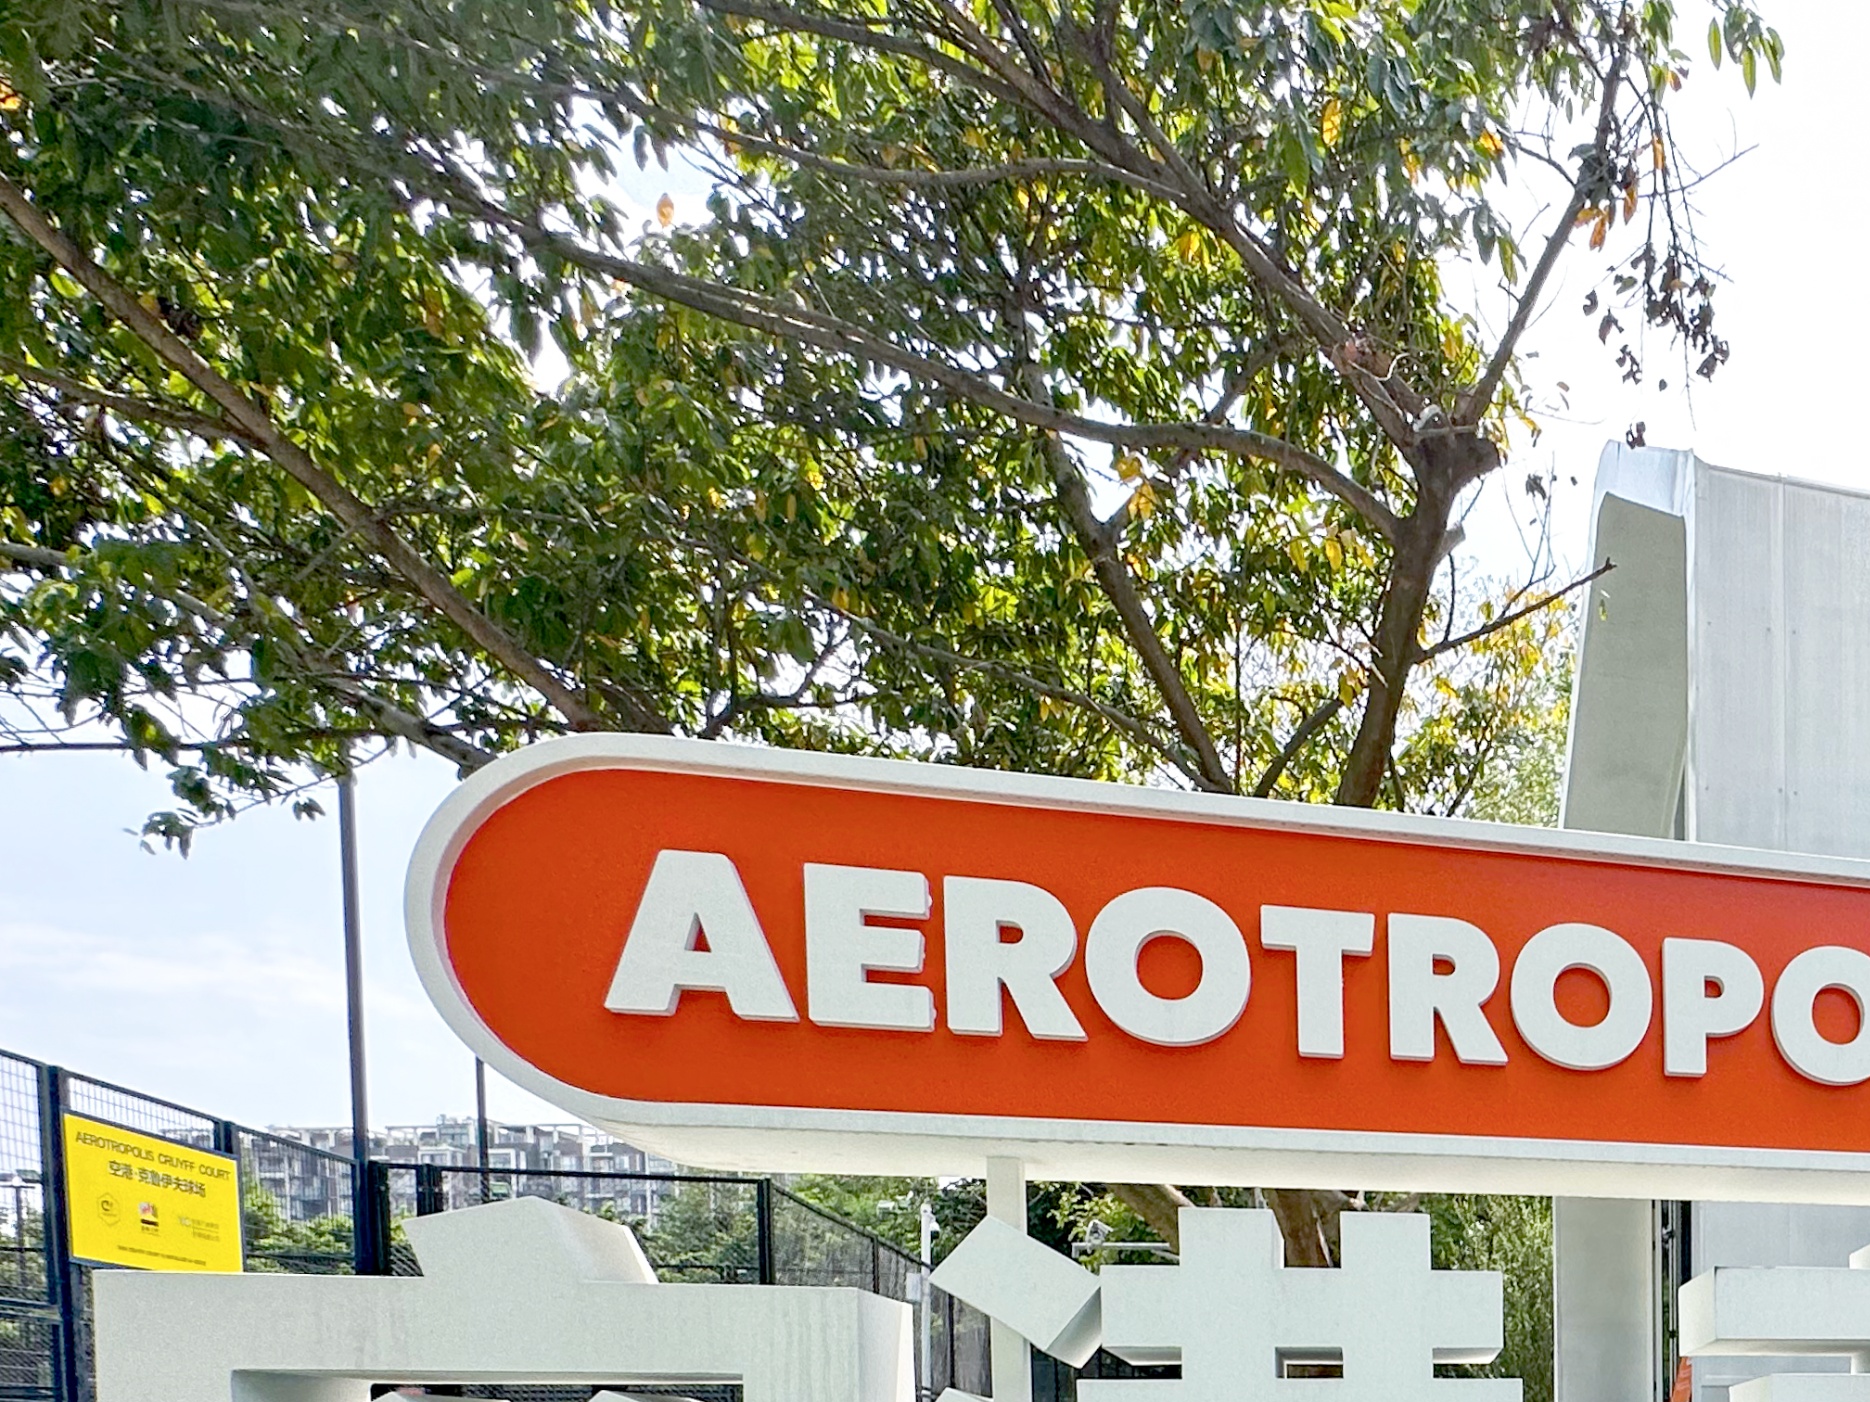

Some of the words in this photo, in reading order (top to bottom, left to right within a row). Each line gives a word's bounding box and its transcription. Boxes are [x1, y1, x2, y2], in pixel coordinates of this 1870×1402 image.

[75, 1131, 155, 1161] AEROTROPOLIS
[158, 1153, 196, 1171] CRUYFF
[199, 1164, 231, 1181] COURT
